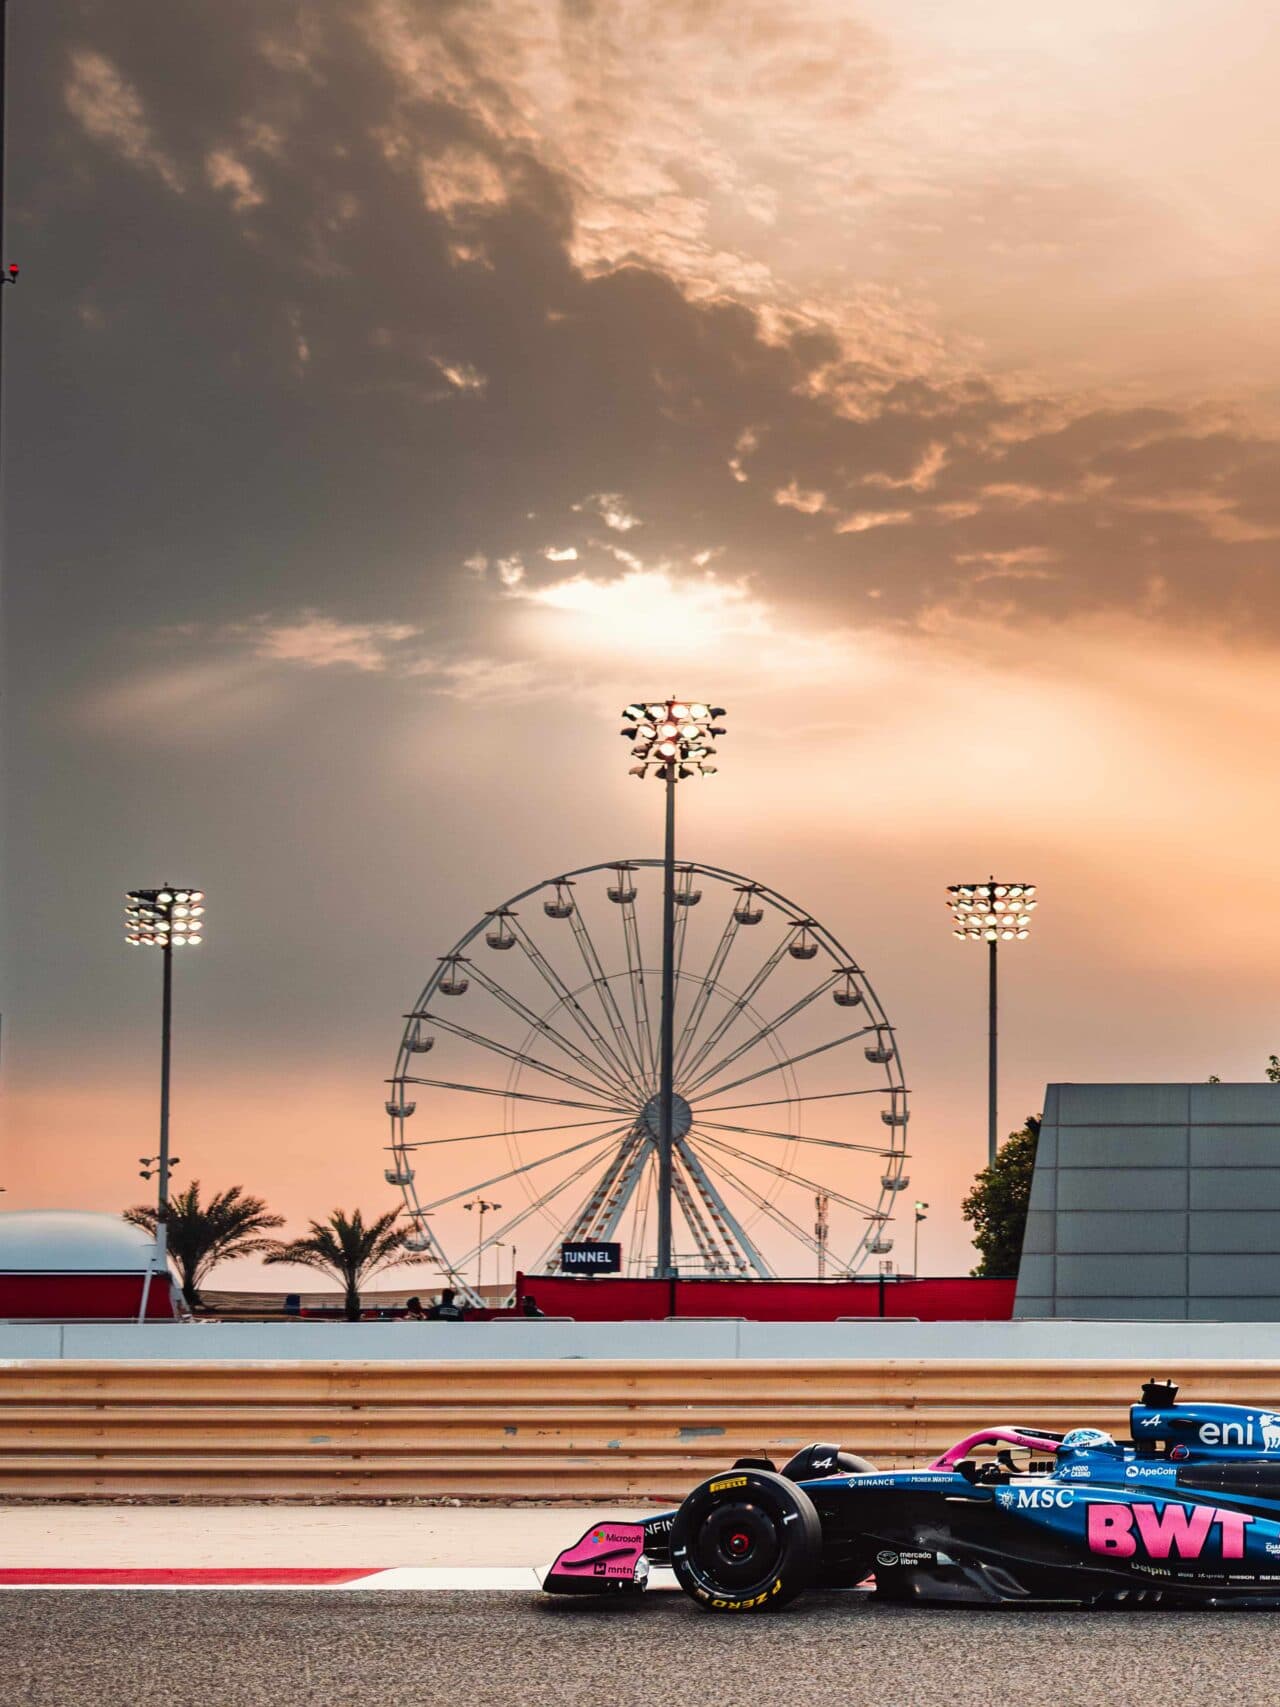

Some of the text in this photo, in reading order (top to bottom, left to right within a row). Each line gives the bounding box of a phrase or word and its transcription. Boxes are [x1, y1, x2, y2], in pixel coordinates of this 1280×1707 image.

[564, 1251, 612, 1263] TUNNEL
[1199, 1416, 1253, 1445] eni
[1139, 1467, 1177, 1477] ApeCoin
[1016, 1489, 1075, 1509] MSC
[1088, 1503, 1254, 1558] BWT
[606, 1534, 642, 1544] Microsoft
[608, 1566, 633, 1574] mntn
[711, 1592, 768, 1609] ZERO
